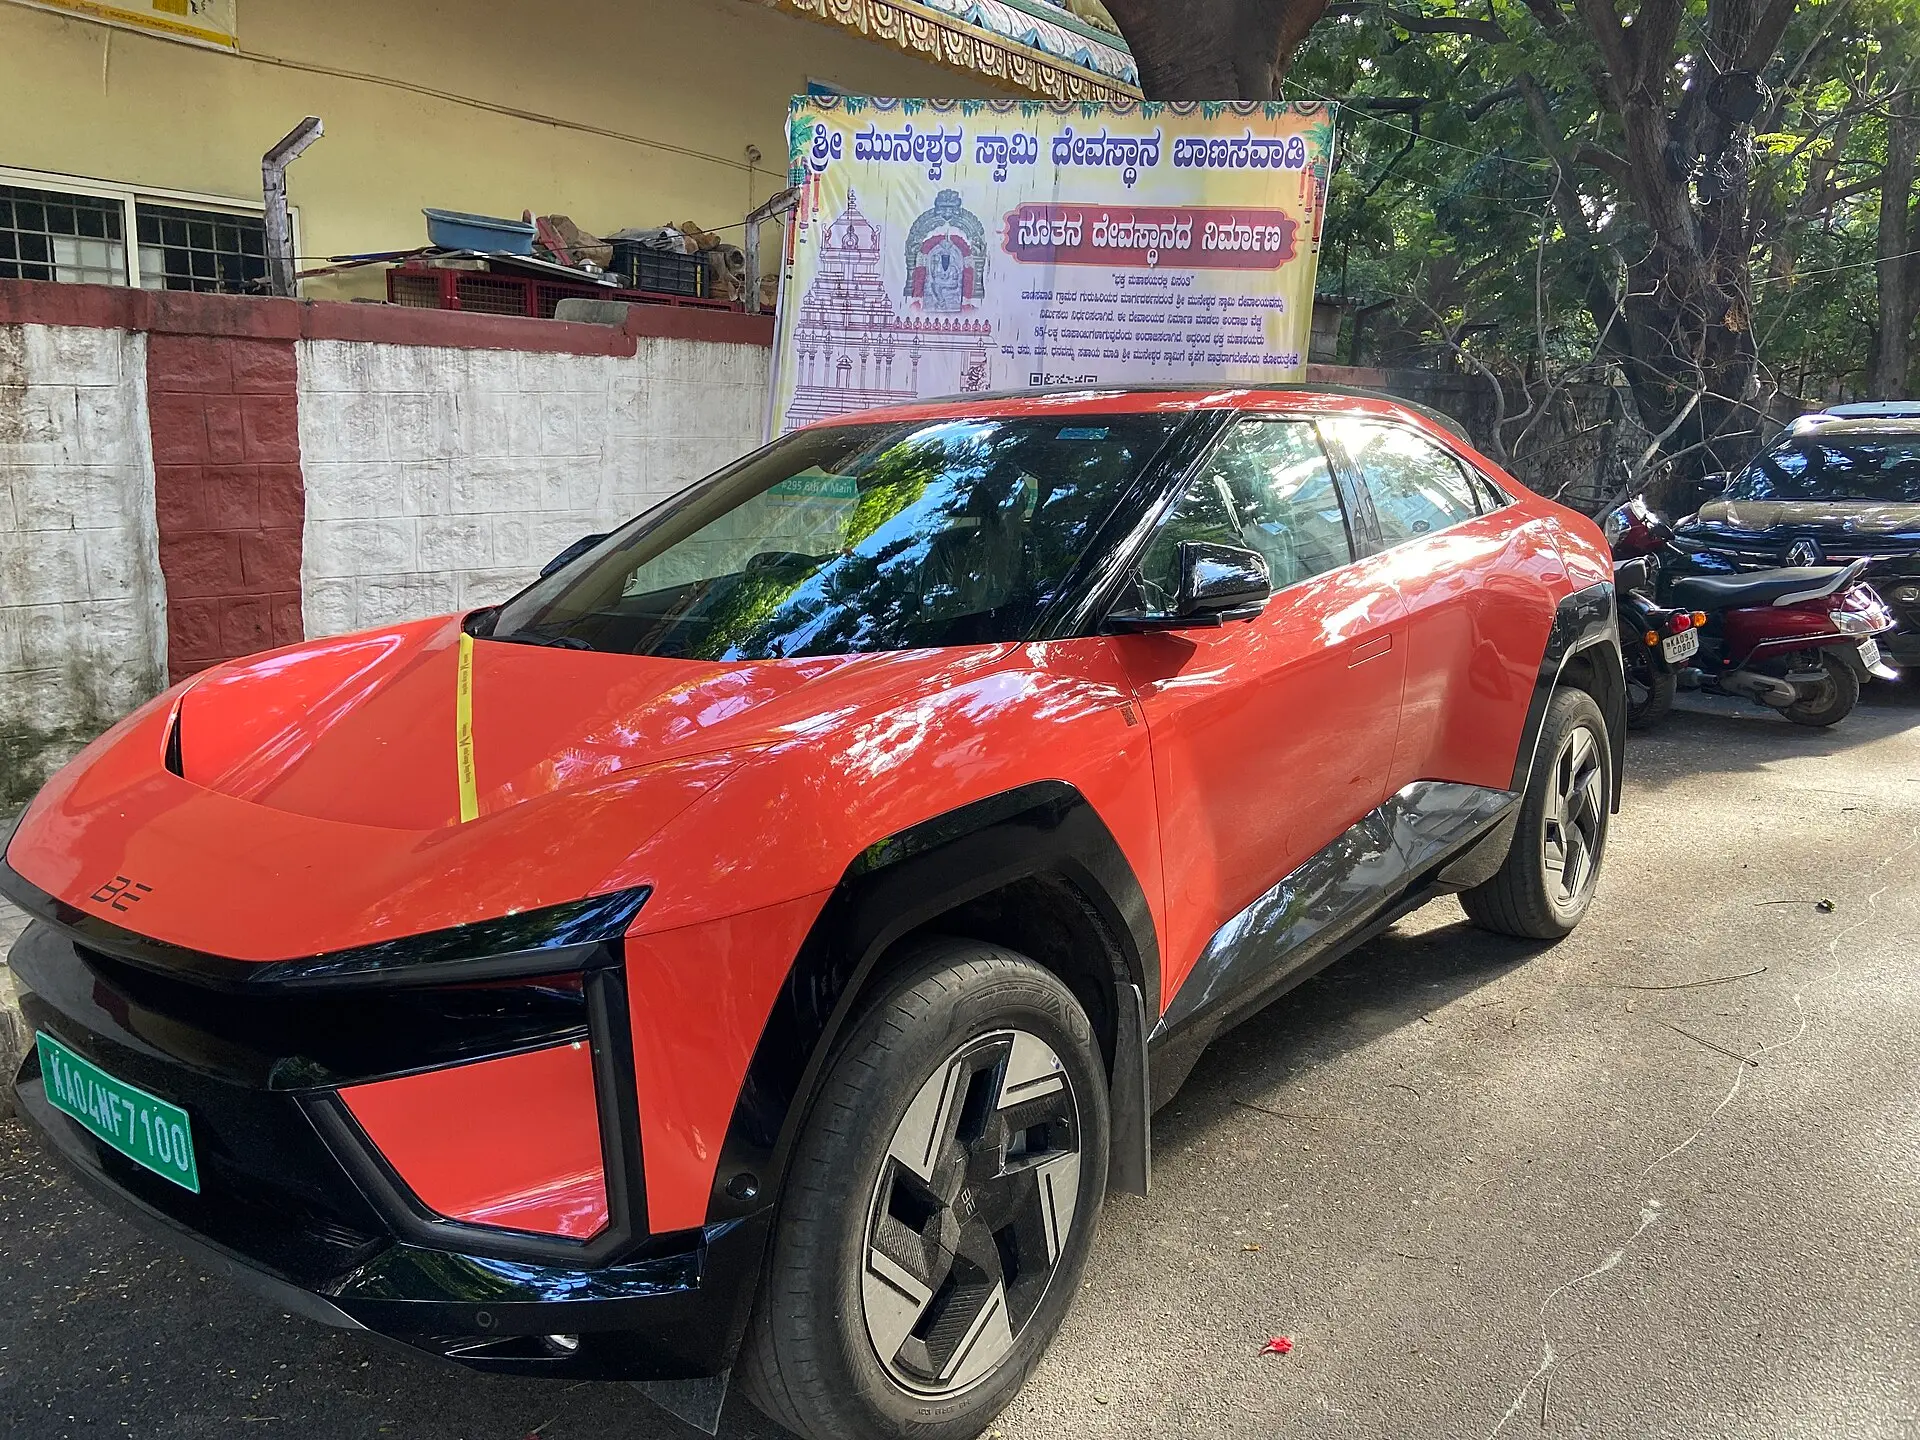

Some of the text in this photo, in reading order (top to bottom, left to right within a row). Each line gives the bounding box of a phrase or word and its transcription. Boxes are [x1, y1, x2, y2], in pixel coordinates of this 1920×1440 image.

[810, 123, 1305, 188] ಶ್ರೀ ಮುನೇಶ್ವರ ಸ್ವಾಮಿ ದೇವಸ್ಥಾನ ಬಾಣಸವಾಡಿ
[1018, 212, 1281, 268] ನೂತನ ದೇವಸ್ಥಾನದ ನಿರ್ಮಾಣ
[1176, 294, 1185, 309] ಶ್ರೀ
[1188, 294, 1216, 311] ಮುನೇಶ್ವರ
[1219, 296, 1235, 311] ಸ್ವಾಮಿ
[1167, 313, 1193, 325] ನಿರ್ಮಾಣ
[830, 482, 852, 494] Main
[1670, 631, 1694, 647] KA09J
[90, 876, 153, 912] BE
[50, 1053, 189, 1172] KA04NF7100
